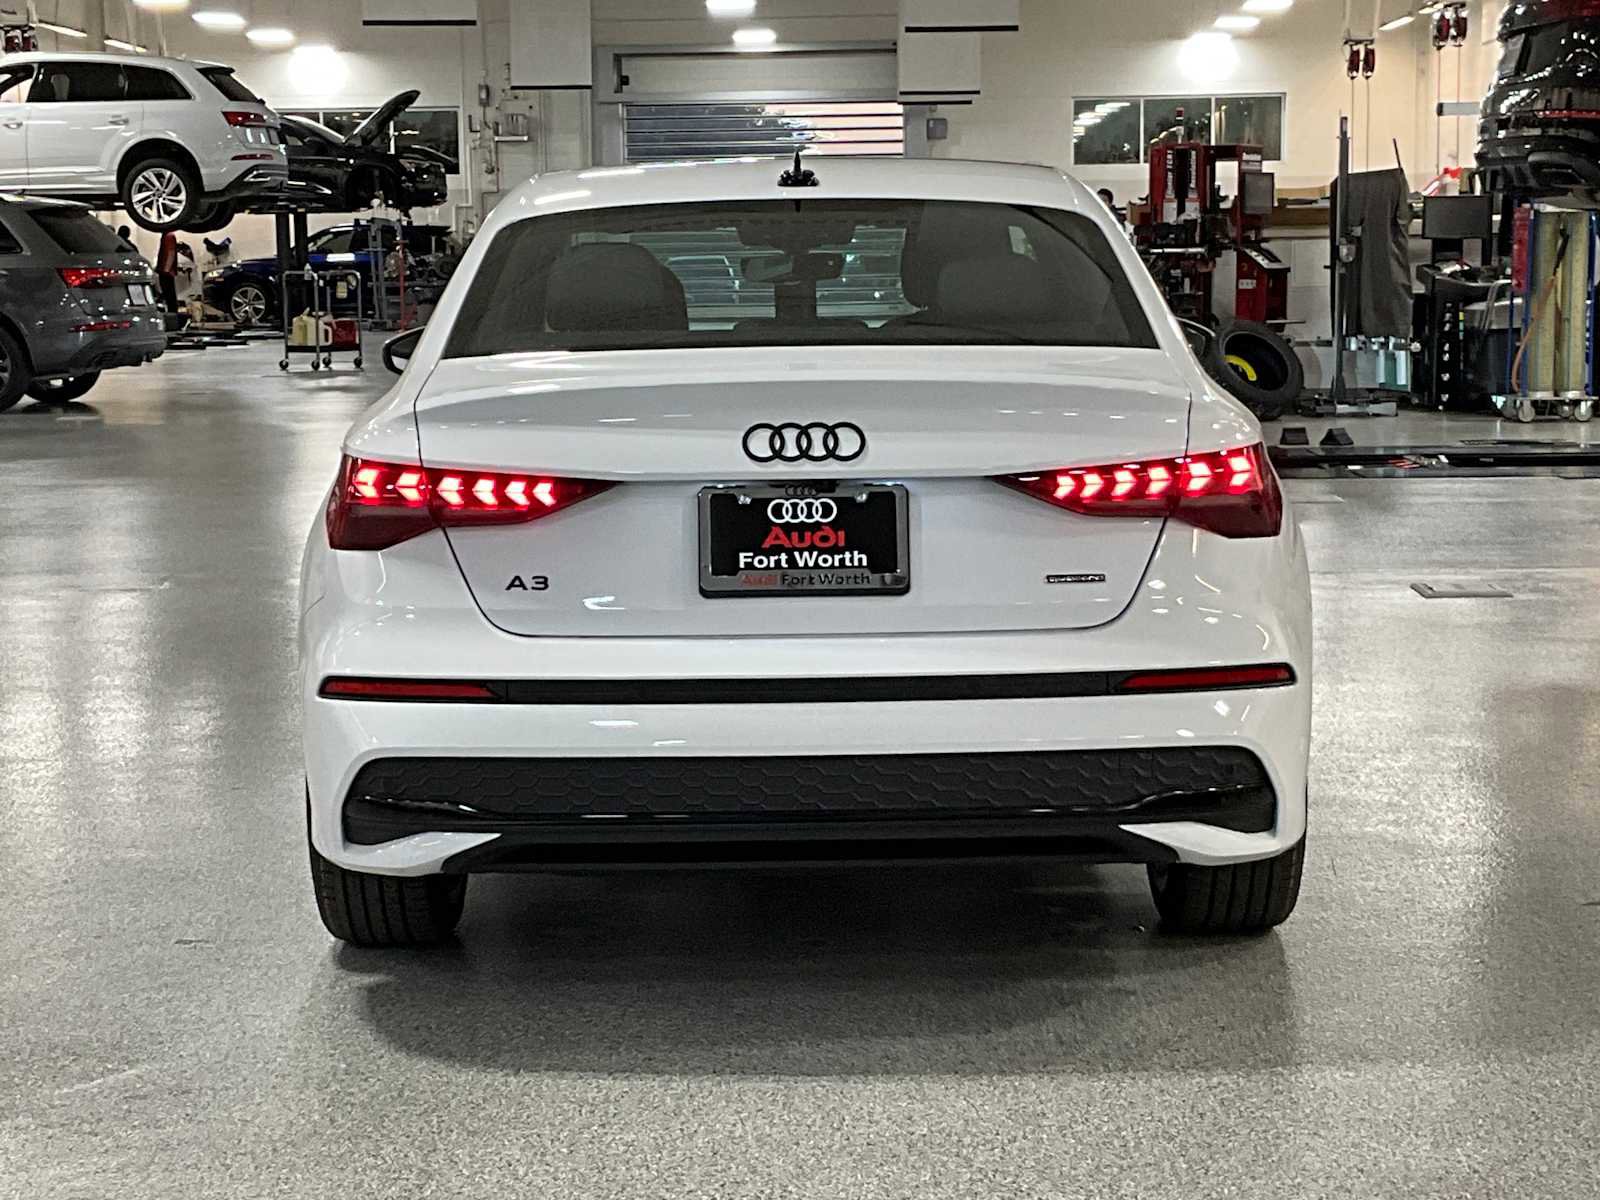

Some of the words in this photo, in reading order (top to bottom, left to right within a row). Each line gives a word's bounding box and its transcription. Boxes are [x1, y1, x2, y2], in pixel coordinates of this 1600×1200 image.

[761, 526, 845, 548] Audi
[738, 552, 788, 568] Fort
[794, 550, 868, 567] Worth
[505, 575, 549, 591] A3
[782, 574, 815, 586] Fort
[818, 573, 871, 585] Worth
